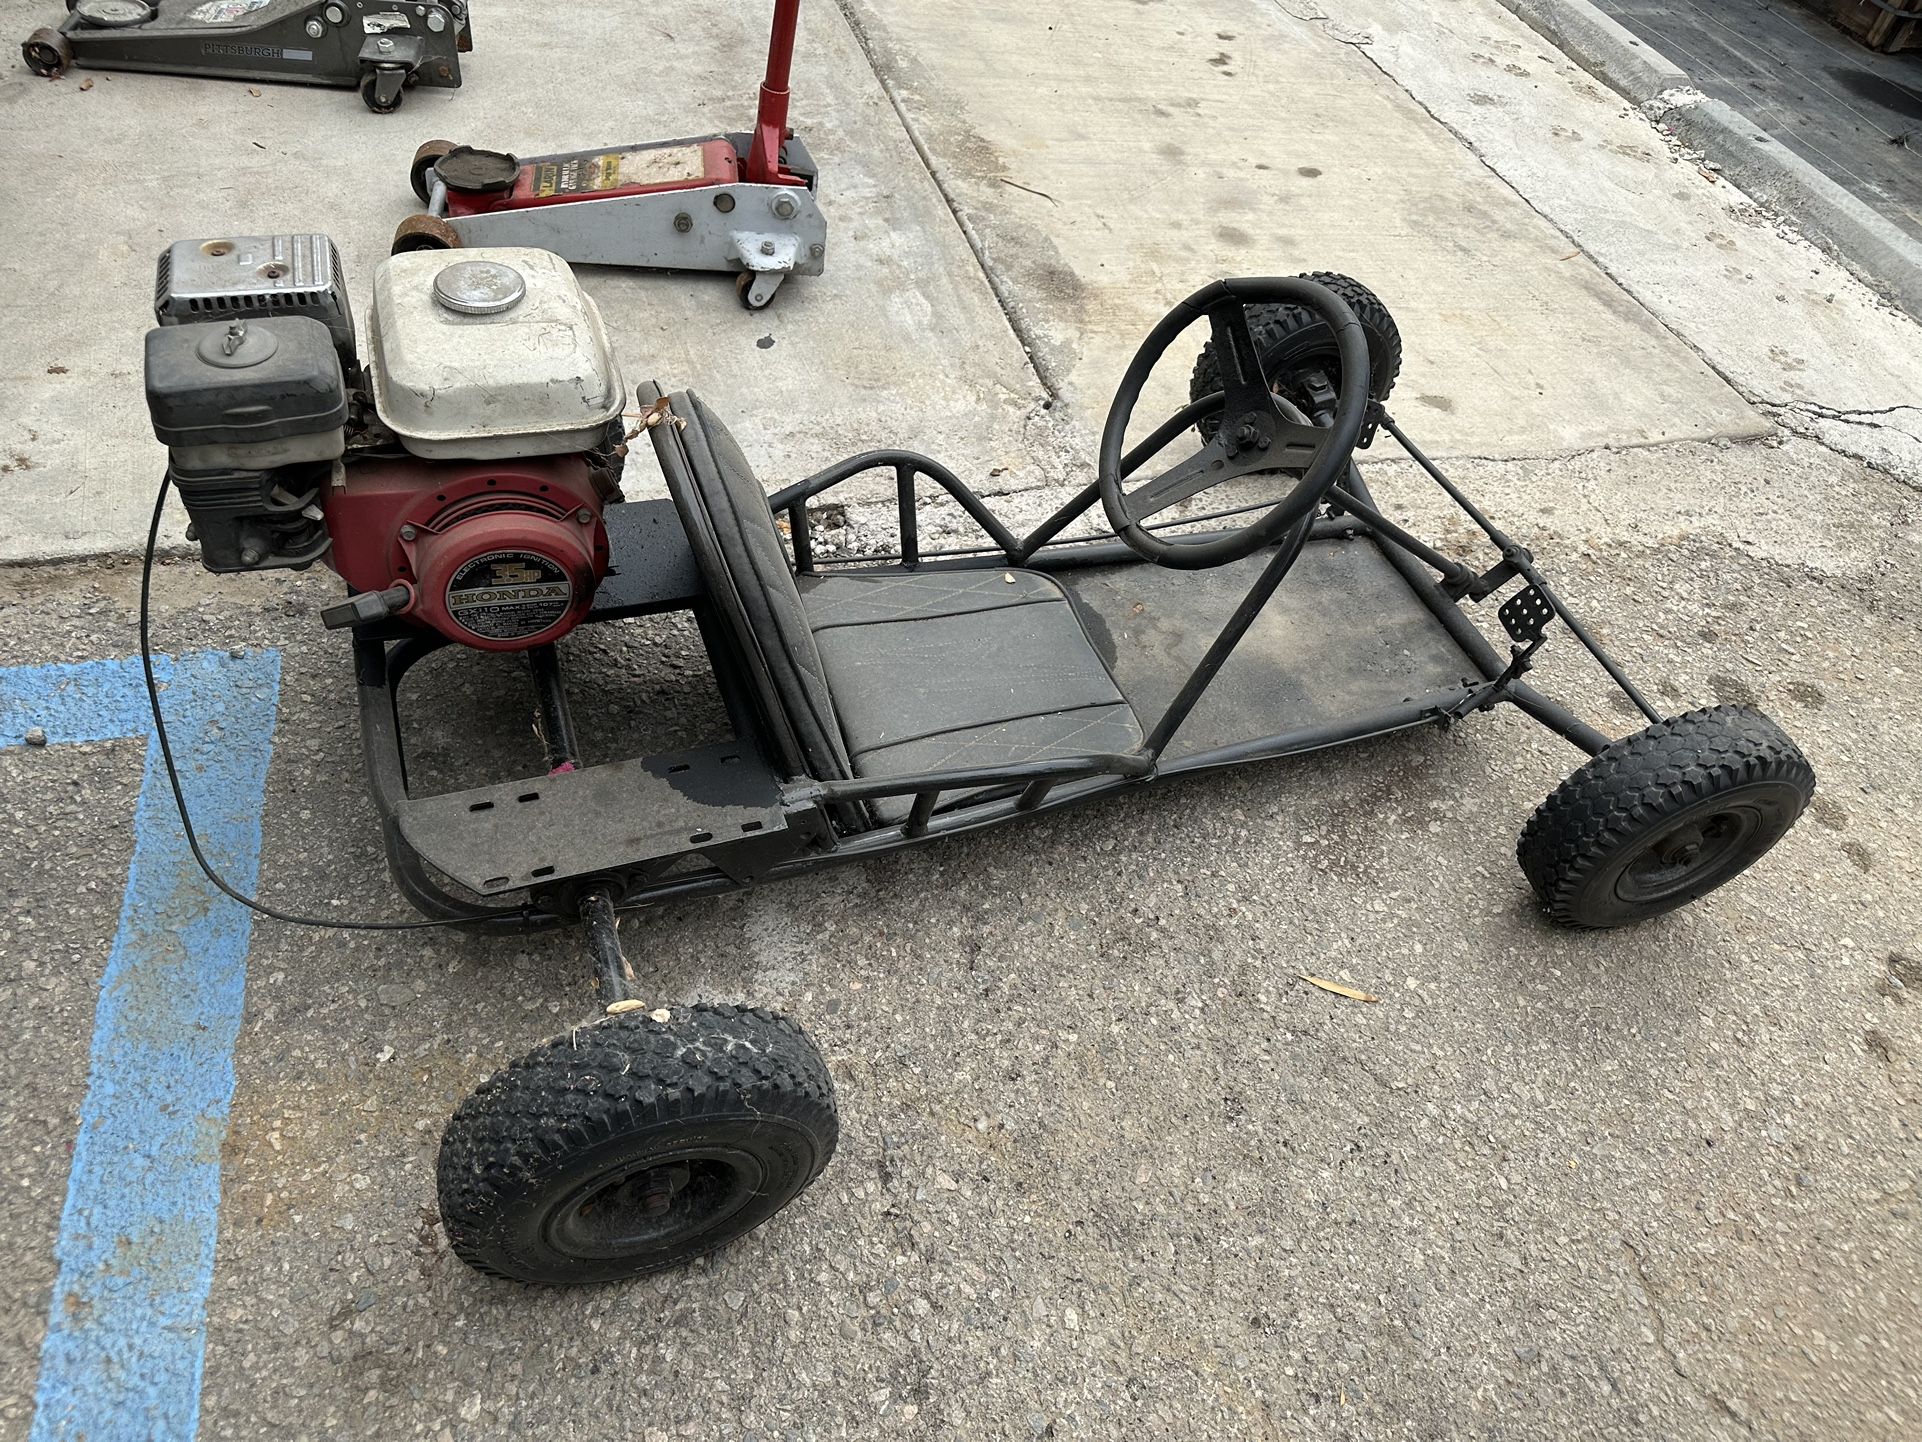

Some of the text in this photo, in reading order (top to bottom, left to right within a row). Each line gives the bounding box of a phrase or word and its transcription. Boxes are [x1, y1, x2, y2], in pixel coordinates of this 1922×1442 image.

[203, 43, 281, 58] PITTSBURGH
[456, 553, 560, 581] ELECTRONIC IGNITION
[451, 585, 567, 606] HONDA
[458, 606, 500, 616] GX110
